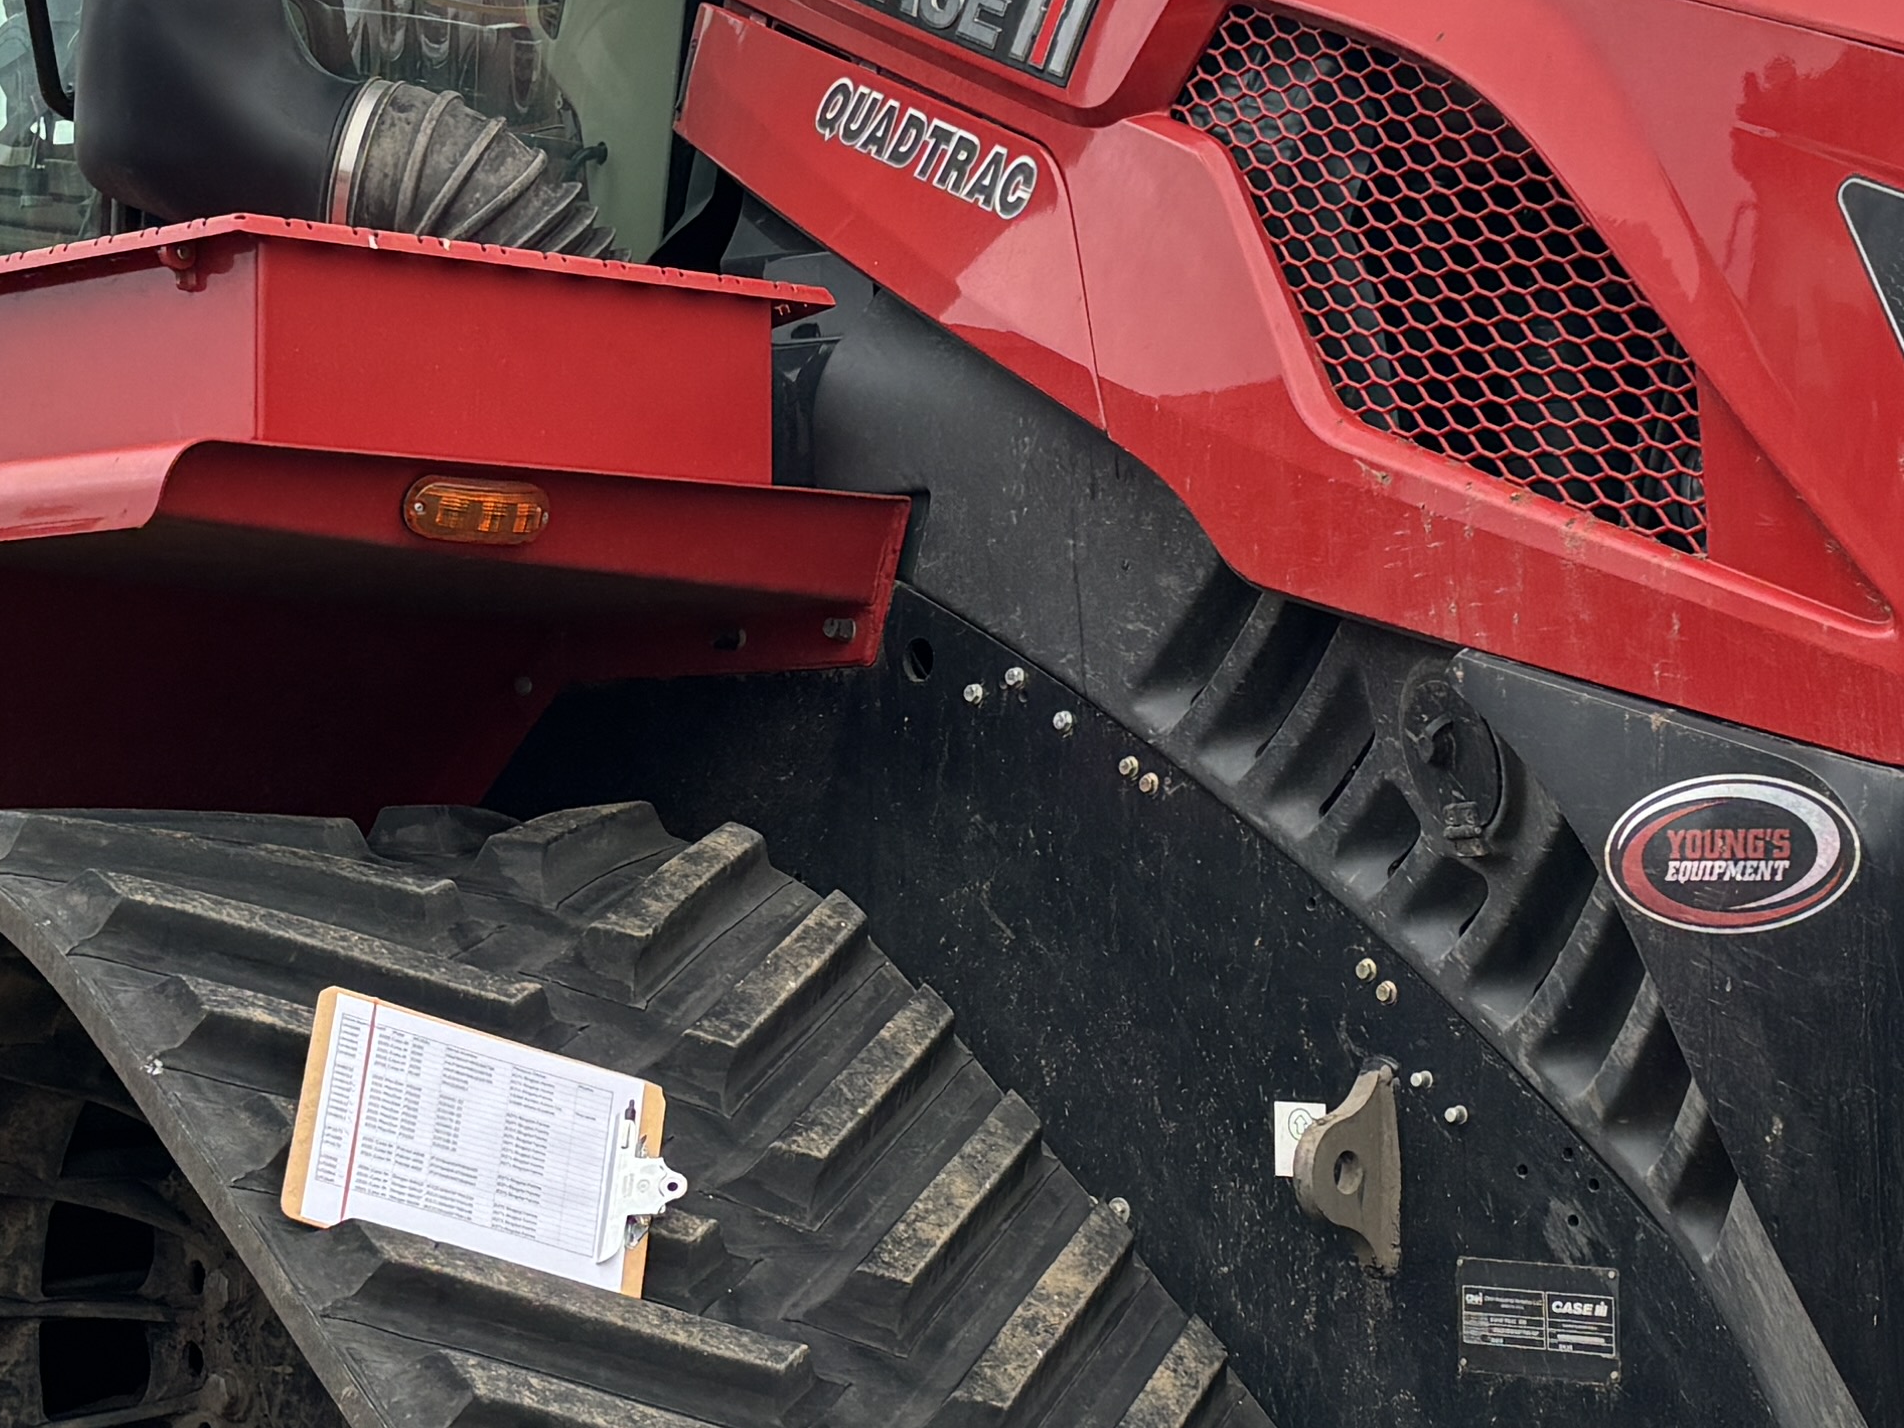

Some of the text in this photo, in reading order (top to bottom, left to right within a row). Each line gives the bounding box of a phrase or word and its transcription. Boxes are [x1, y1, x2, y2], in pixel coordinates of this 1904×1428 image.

[815, 76, 1038, 220] QUADTRAC
[1665, 828, 1792, 860] YOUNG'S
[1664, 859, 1790, 884] EQUIPMENT
[1551, 1300, 1594, 1316] CASE
